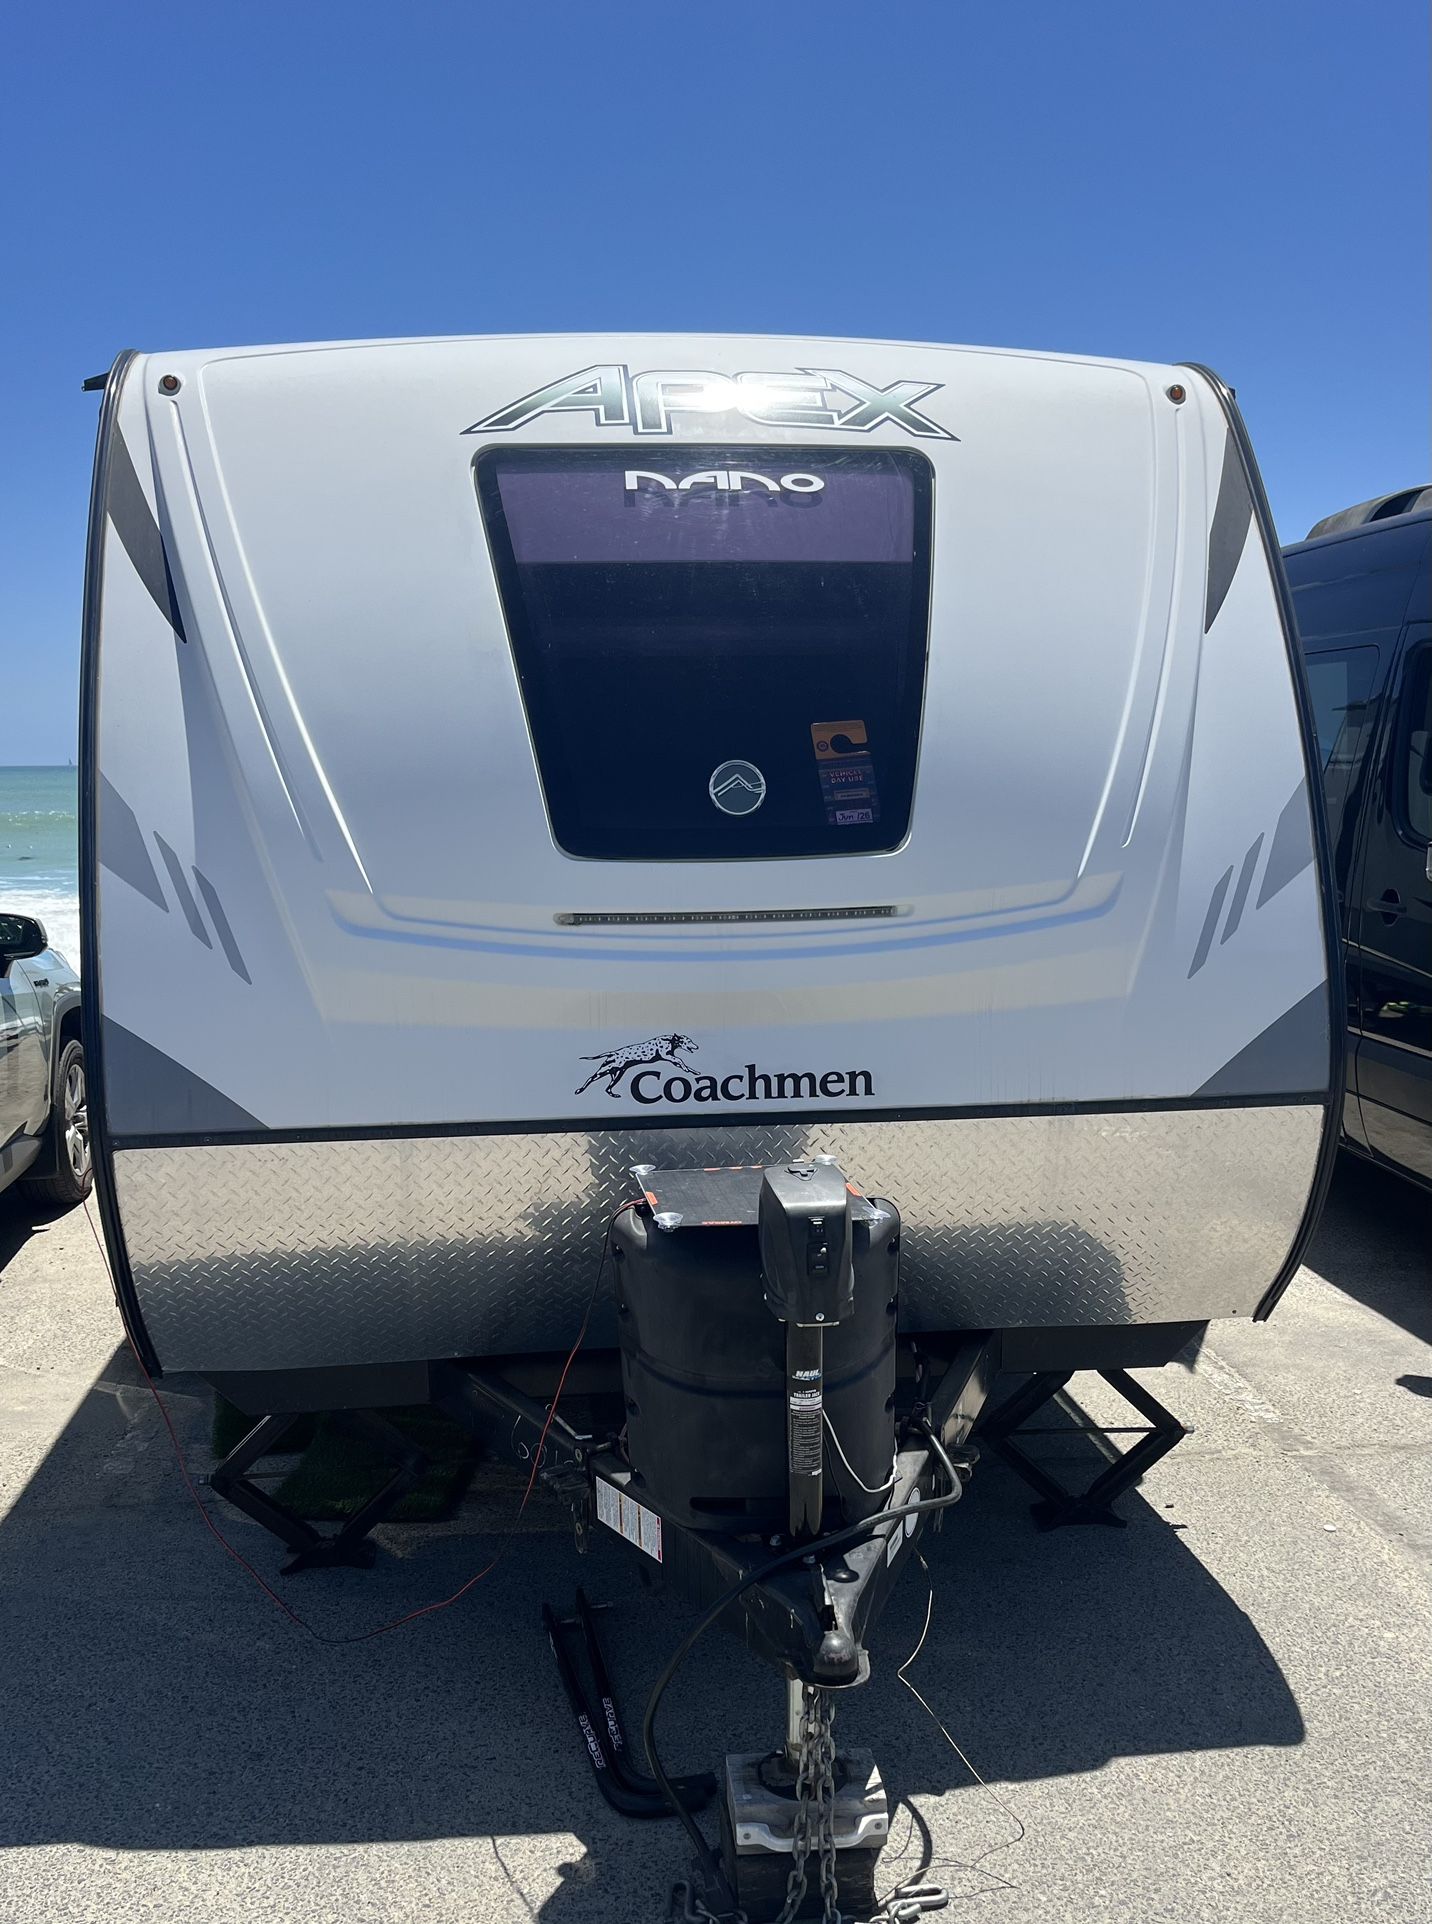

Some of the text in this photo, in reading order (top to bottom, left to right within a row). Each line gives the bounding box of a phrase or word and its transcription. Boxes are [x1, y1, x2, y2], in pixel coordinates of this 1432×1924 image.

[460, 364, 961, 441] APEX
[630, 1064, 876, 1104] Coachmen
[579, 1714, 606, 1769] RECURVE
[602, 1697, 623, 1751] RECURVE
